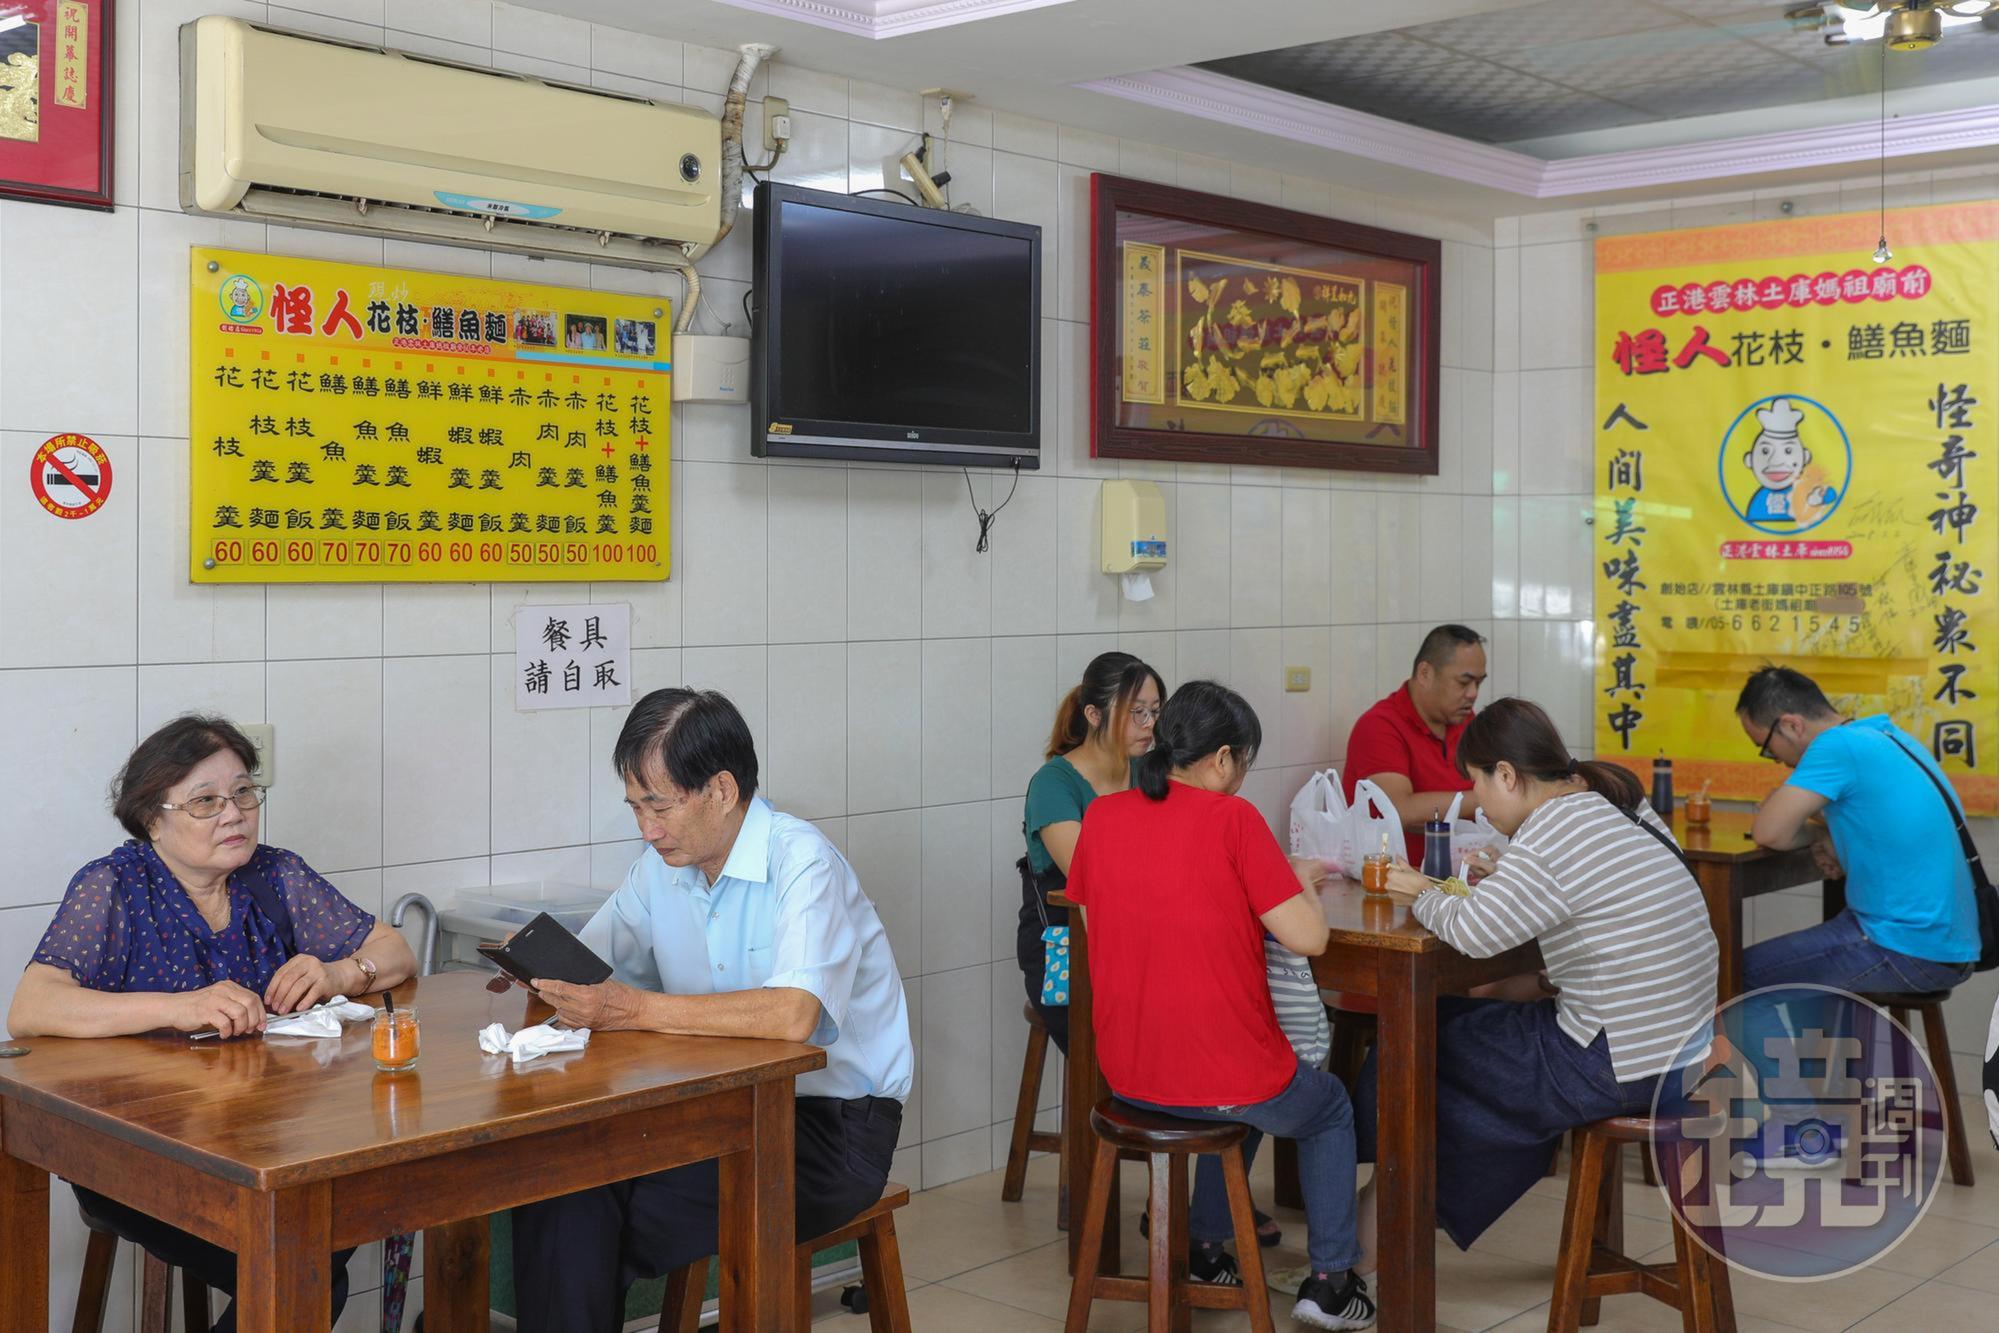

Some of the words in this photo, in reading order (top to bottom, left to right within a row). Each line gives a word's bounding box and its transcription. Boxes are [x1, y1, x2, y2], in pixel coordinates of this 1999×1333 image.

[1656, 268, 1928, 313] 正港雲林土庫媽祖廟前
[215, 540, 242, 562] 60
[252, 541, 279, 562] 60
[287, 541, 314, 562] 60
[322, 542, 348, 562] 70
[355, 543, 380, 562] 70
[387, 543, 412, 563] 70
[418, 542, 443, 562] 60
[450, 542, 472, 563] 60
[480, 543, 503, 562] 60
[510, 543, 532, 563] 50
[538, 543, 560, 563] 50
[566, 544, 588, 563] 50
[593, 544, 623, 563] 100
[627, 544, 657, 563] 100
[1603, 403, 1648, 750] 人間美味盡其中
[542, 616, 608, 652] 餐具
[524, 659, 622, 694] 請自取
